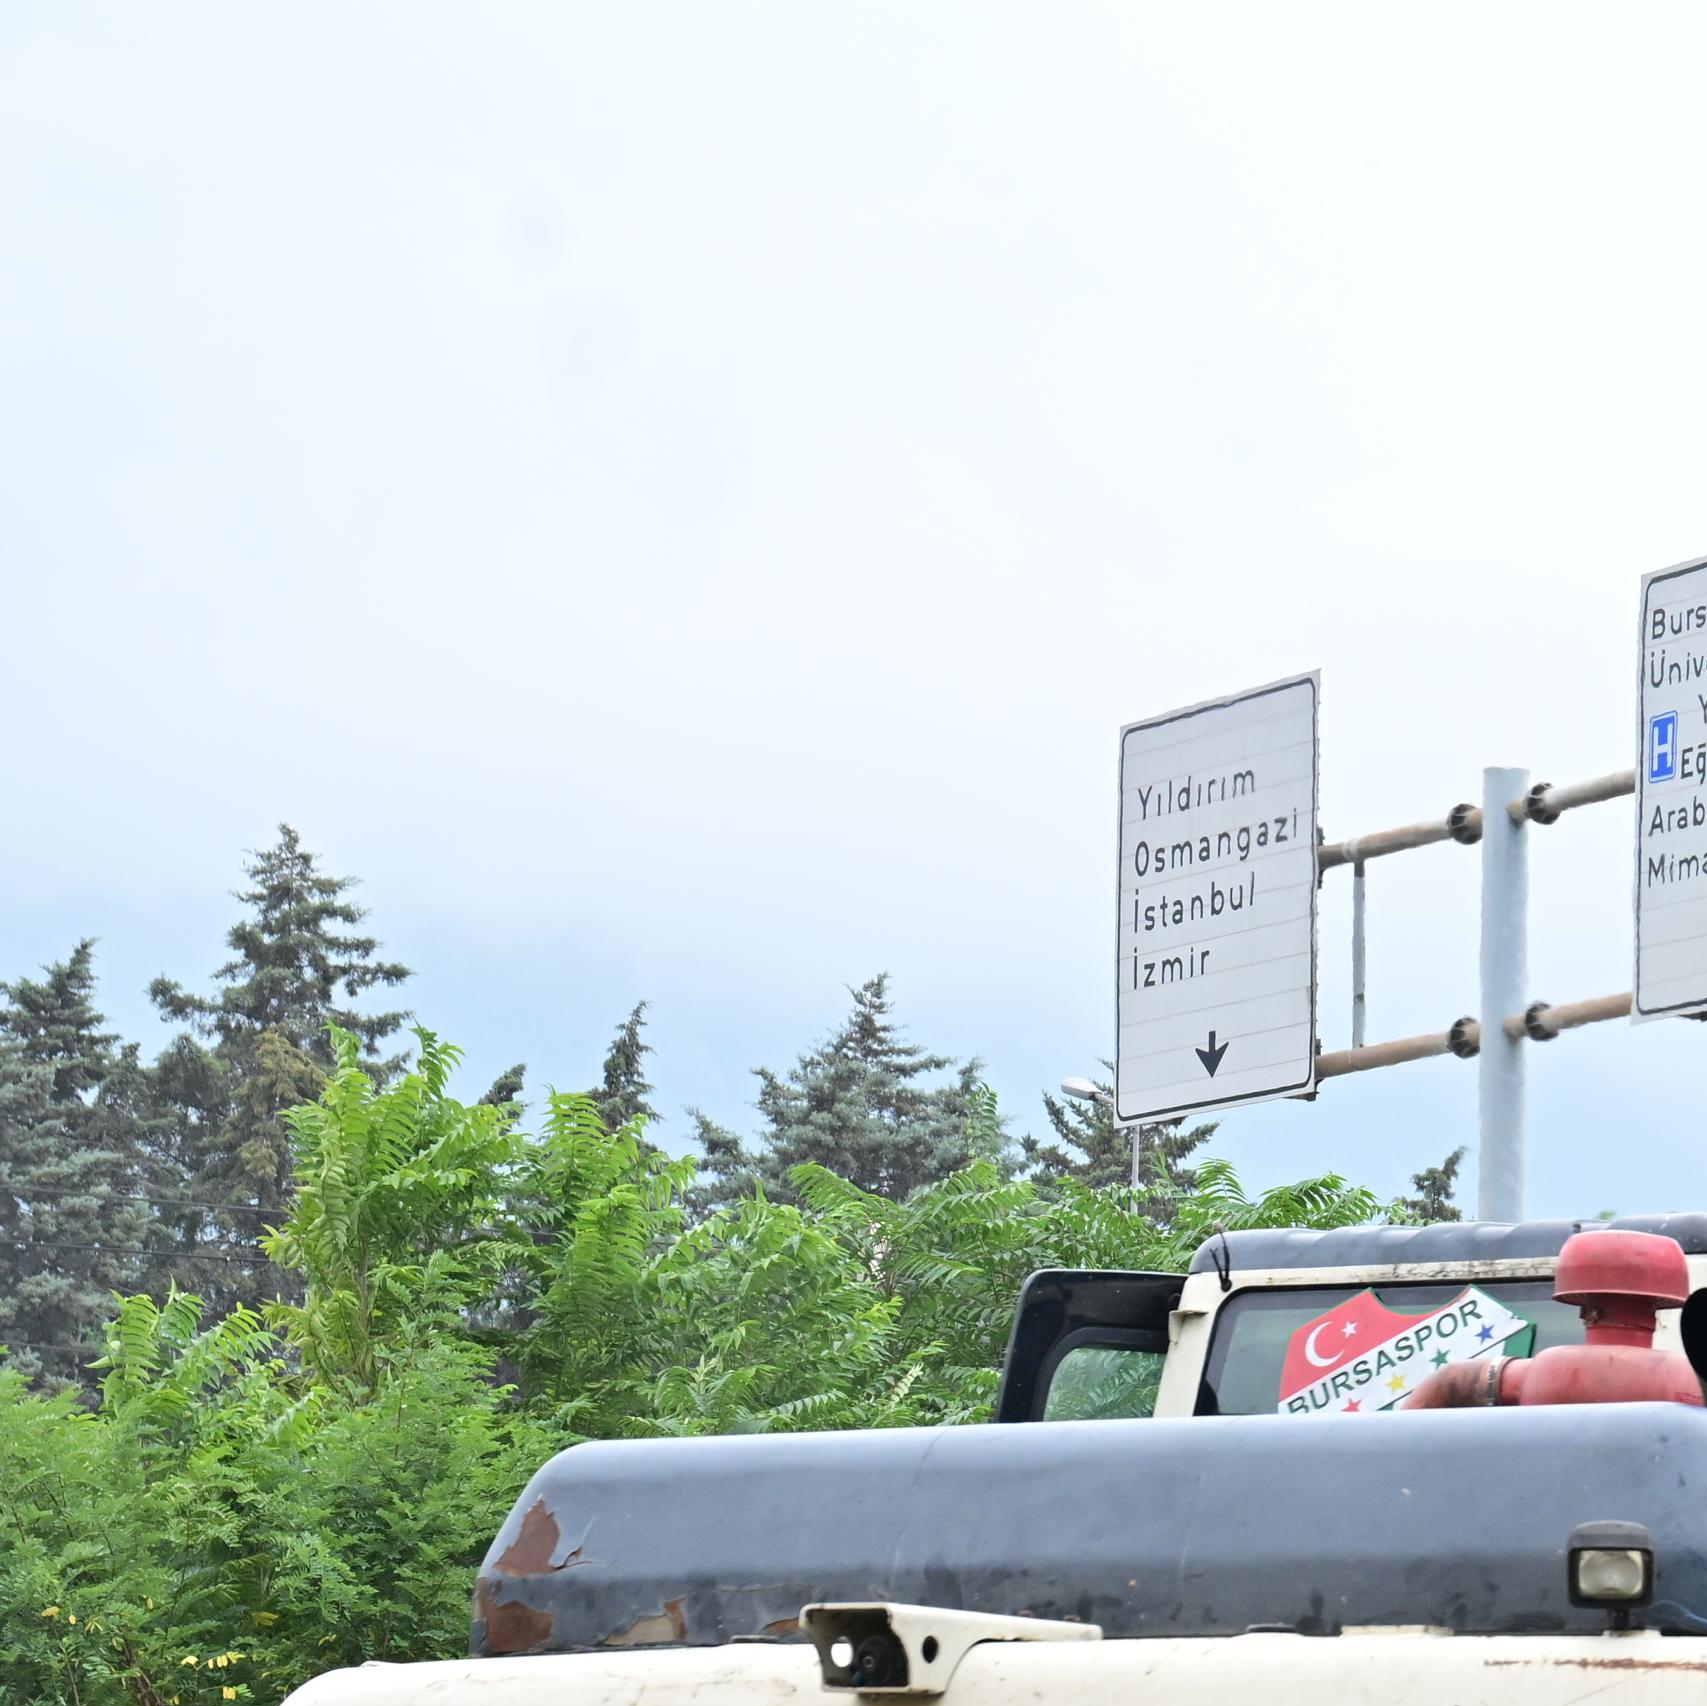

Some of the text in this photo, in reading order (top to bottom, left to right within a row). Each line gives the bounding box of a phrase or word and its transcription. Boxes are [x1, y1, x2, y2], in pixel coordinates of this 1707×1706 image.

[1138, 769, 1255, 821] Yıldırım
[1135, 808, 1298, 877] Osmangazi
[1133, 871, 1255, 933] İstanbul
[1133, 946, 1211, 991] İzmir
[1287, 1299, 1483, 1414] BURSASPOR
